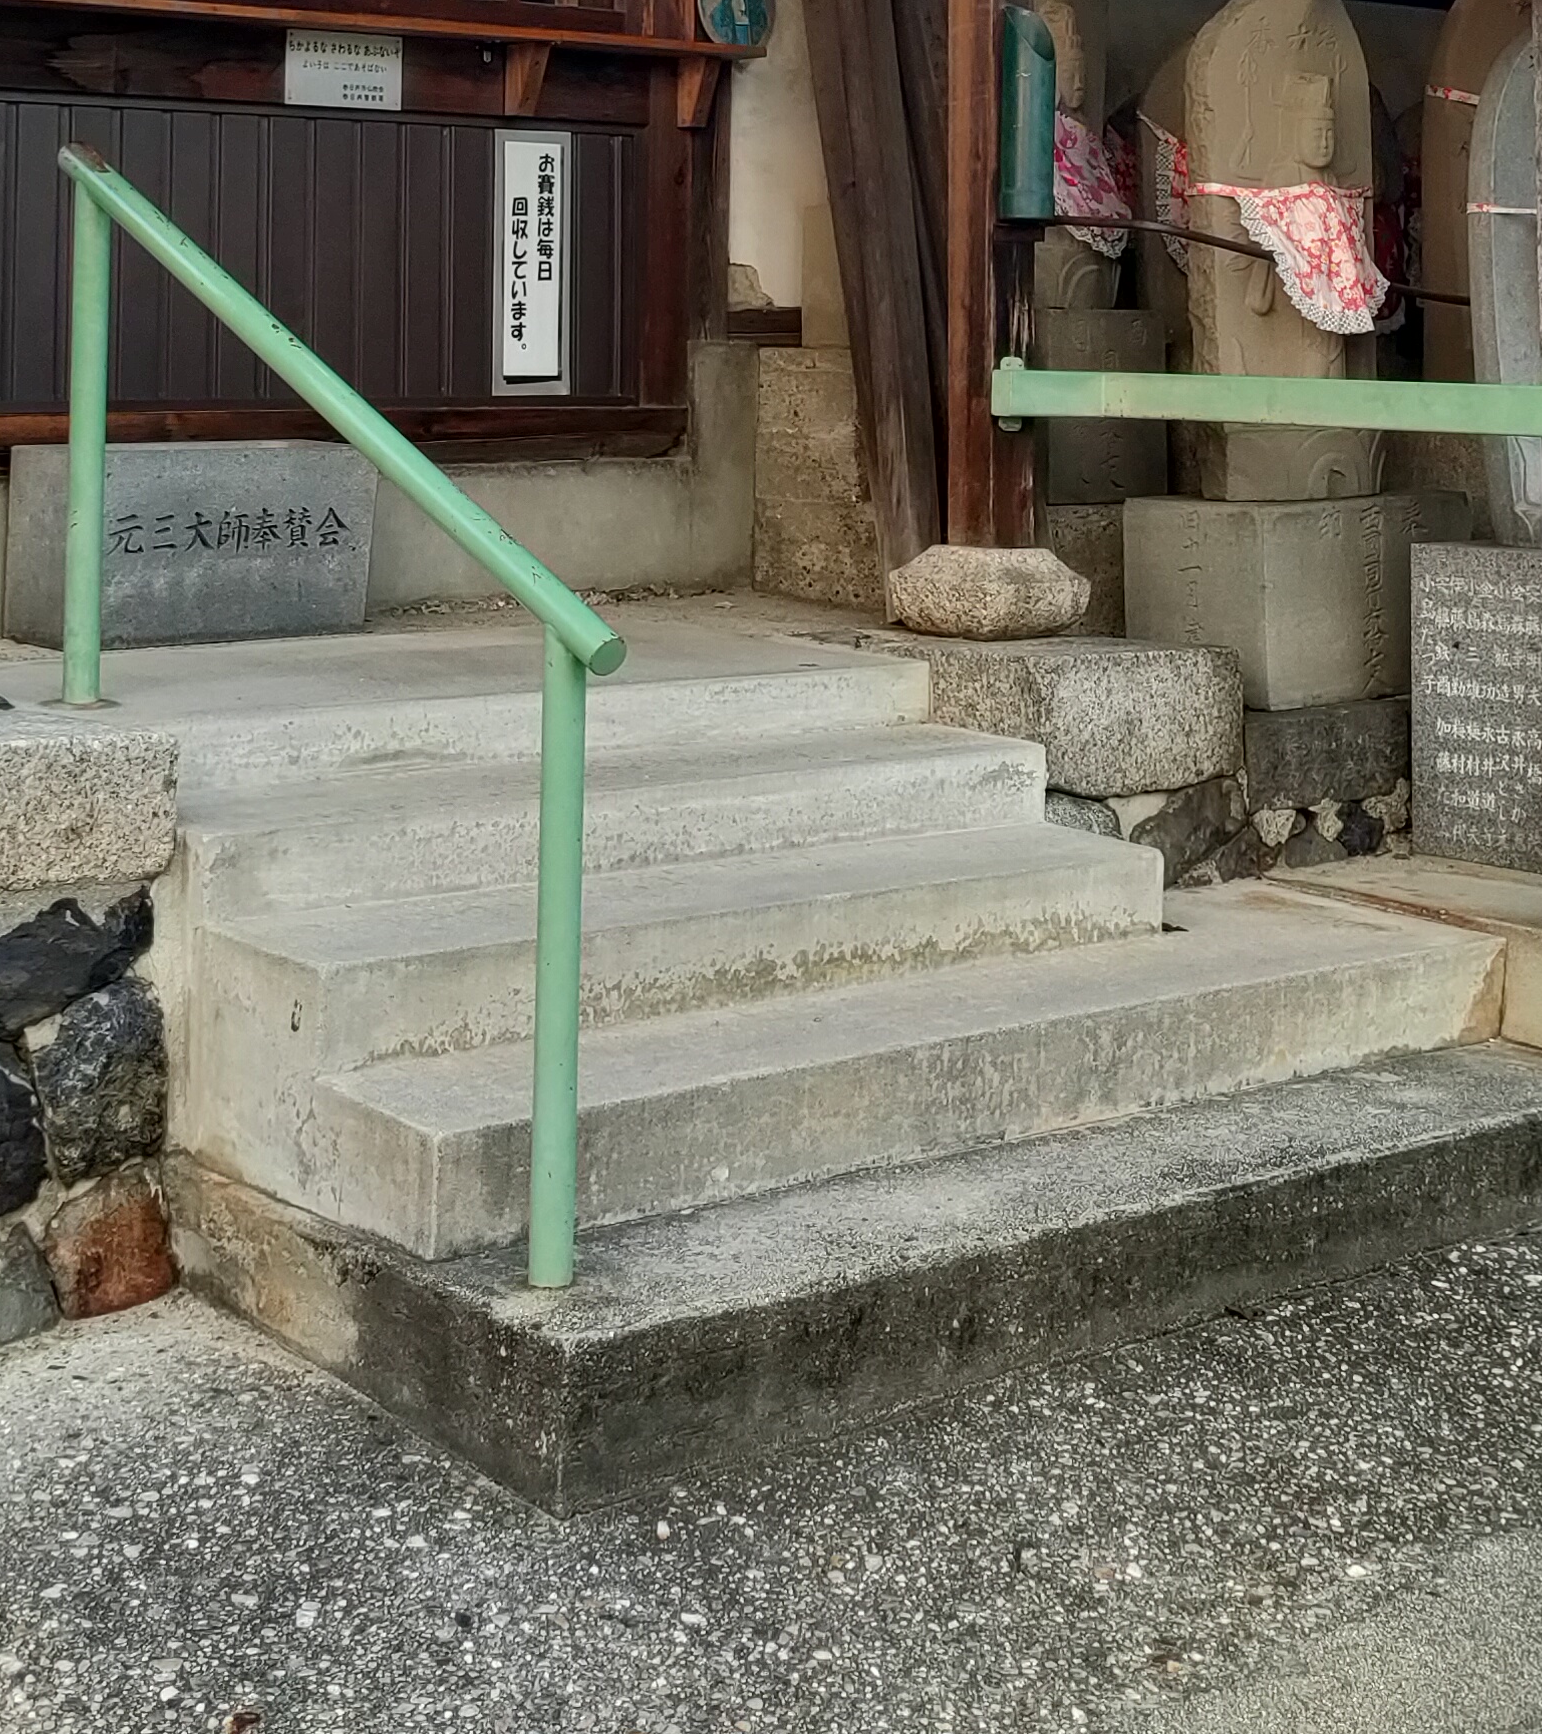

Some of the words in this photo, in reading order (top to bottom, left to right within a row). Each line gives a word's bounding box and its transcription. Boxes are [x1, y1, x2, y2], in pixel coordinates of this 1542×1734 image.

[289, 40, 327, 54] ちかよるな
[330, 43, 361, 56] さわるな
[537, 152, 555, 281] お賽銭は毎日
[510, 196, 528, 351] 回収しています。
[107, 506, 351, 556] 元三大師奉賛会
